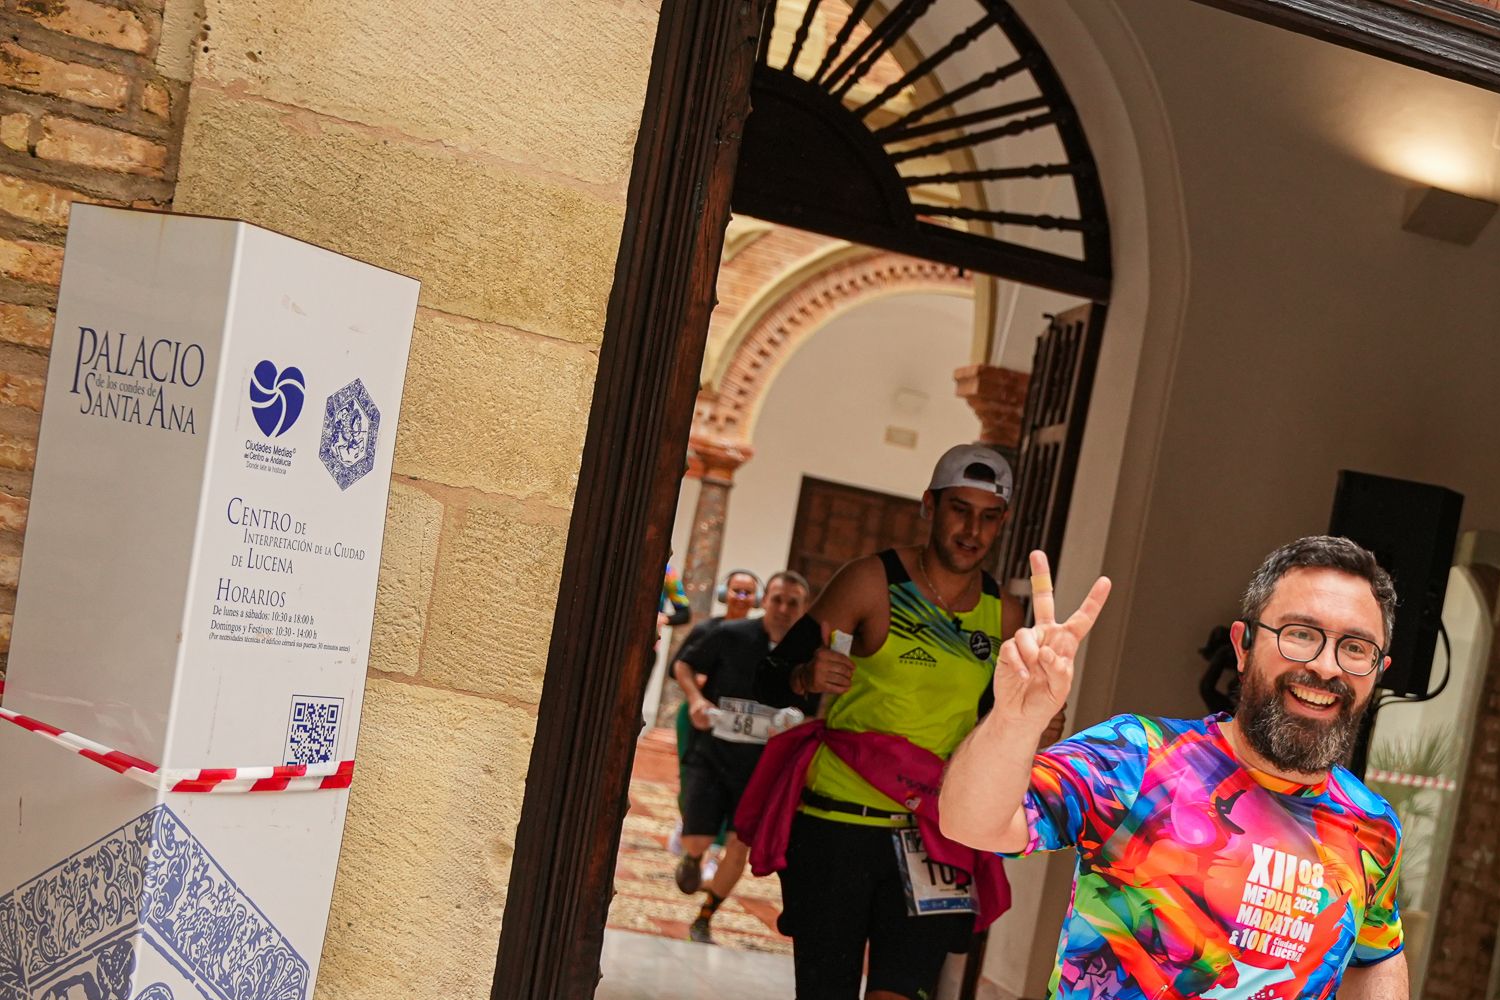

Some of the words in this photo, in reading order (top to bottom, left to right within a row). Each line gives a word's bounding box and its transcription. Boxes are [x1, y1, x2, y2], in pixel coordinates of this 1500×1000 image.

[70, 326, 205, 394] PALACIO
[95, 374, 105, 388] de
[106, 376, 118, 391] los
[119, 380, 146, 396] condes
[146, 383, 157, 398] de
[80, 372, 142, 425] SANTA
[146, 385, 196, 435] ANA
[245, 439, 272, 454] Ciudades
[249, 451, 265, 462] Centro
[227, 497, 292, 533] CENTRO
[294, 521, 307, 535] DE
[243, 528, 313, 553] INTERPRETACIÓN
[314, 544, 323, 555] DE
[324, 547, 332, 556] LA
[333, 542, 366, 561] CIUDAD
[231, 554, 243, 568] DE
[247, 547, 294, 574] LUCENA
[216, 577, 287, 608] HORARIOS
[212, 604, 223, 615] De
[223, 605, 239, 617] lunes
[245, 609, 270, 621] sábados:
[271, 611, 288, 622] 10:30
[293, 613, 310, 625] 18:00
[210, 619, 242, 634] Domingos
[247, 623, 274, 636] Festivos:
[275, 625, 292, 637] 10:30
[296, 627, 313, 640] 14:00
[1246, 842, 1298, 895] XII
[1298, 858, 1325, 888] 08
[1241, 881, 1293, 916] MEDIA
[1292, 896, 1320, 915] 2026
[1235, 903, 1315, 944] MARATÓN
[1228, 929, 1240, 945] &
[1239, 928, 1273, 955] 10K
[1269, 945, 1303, 963] LUCENA
[1272, 936, 1298, 950] Ciudad
[1297, 944, 1307, 953] de
